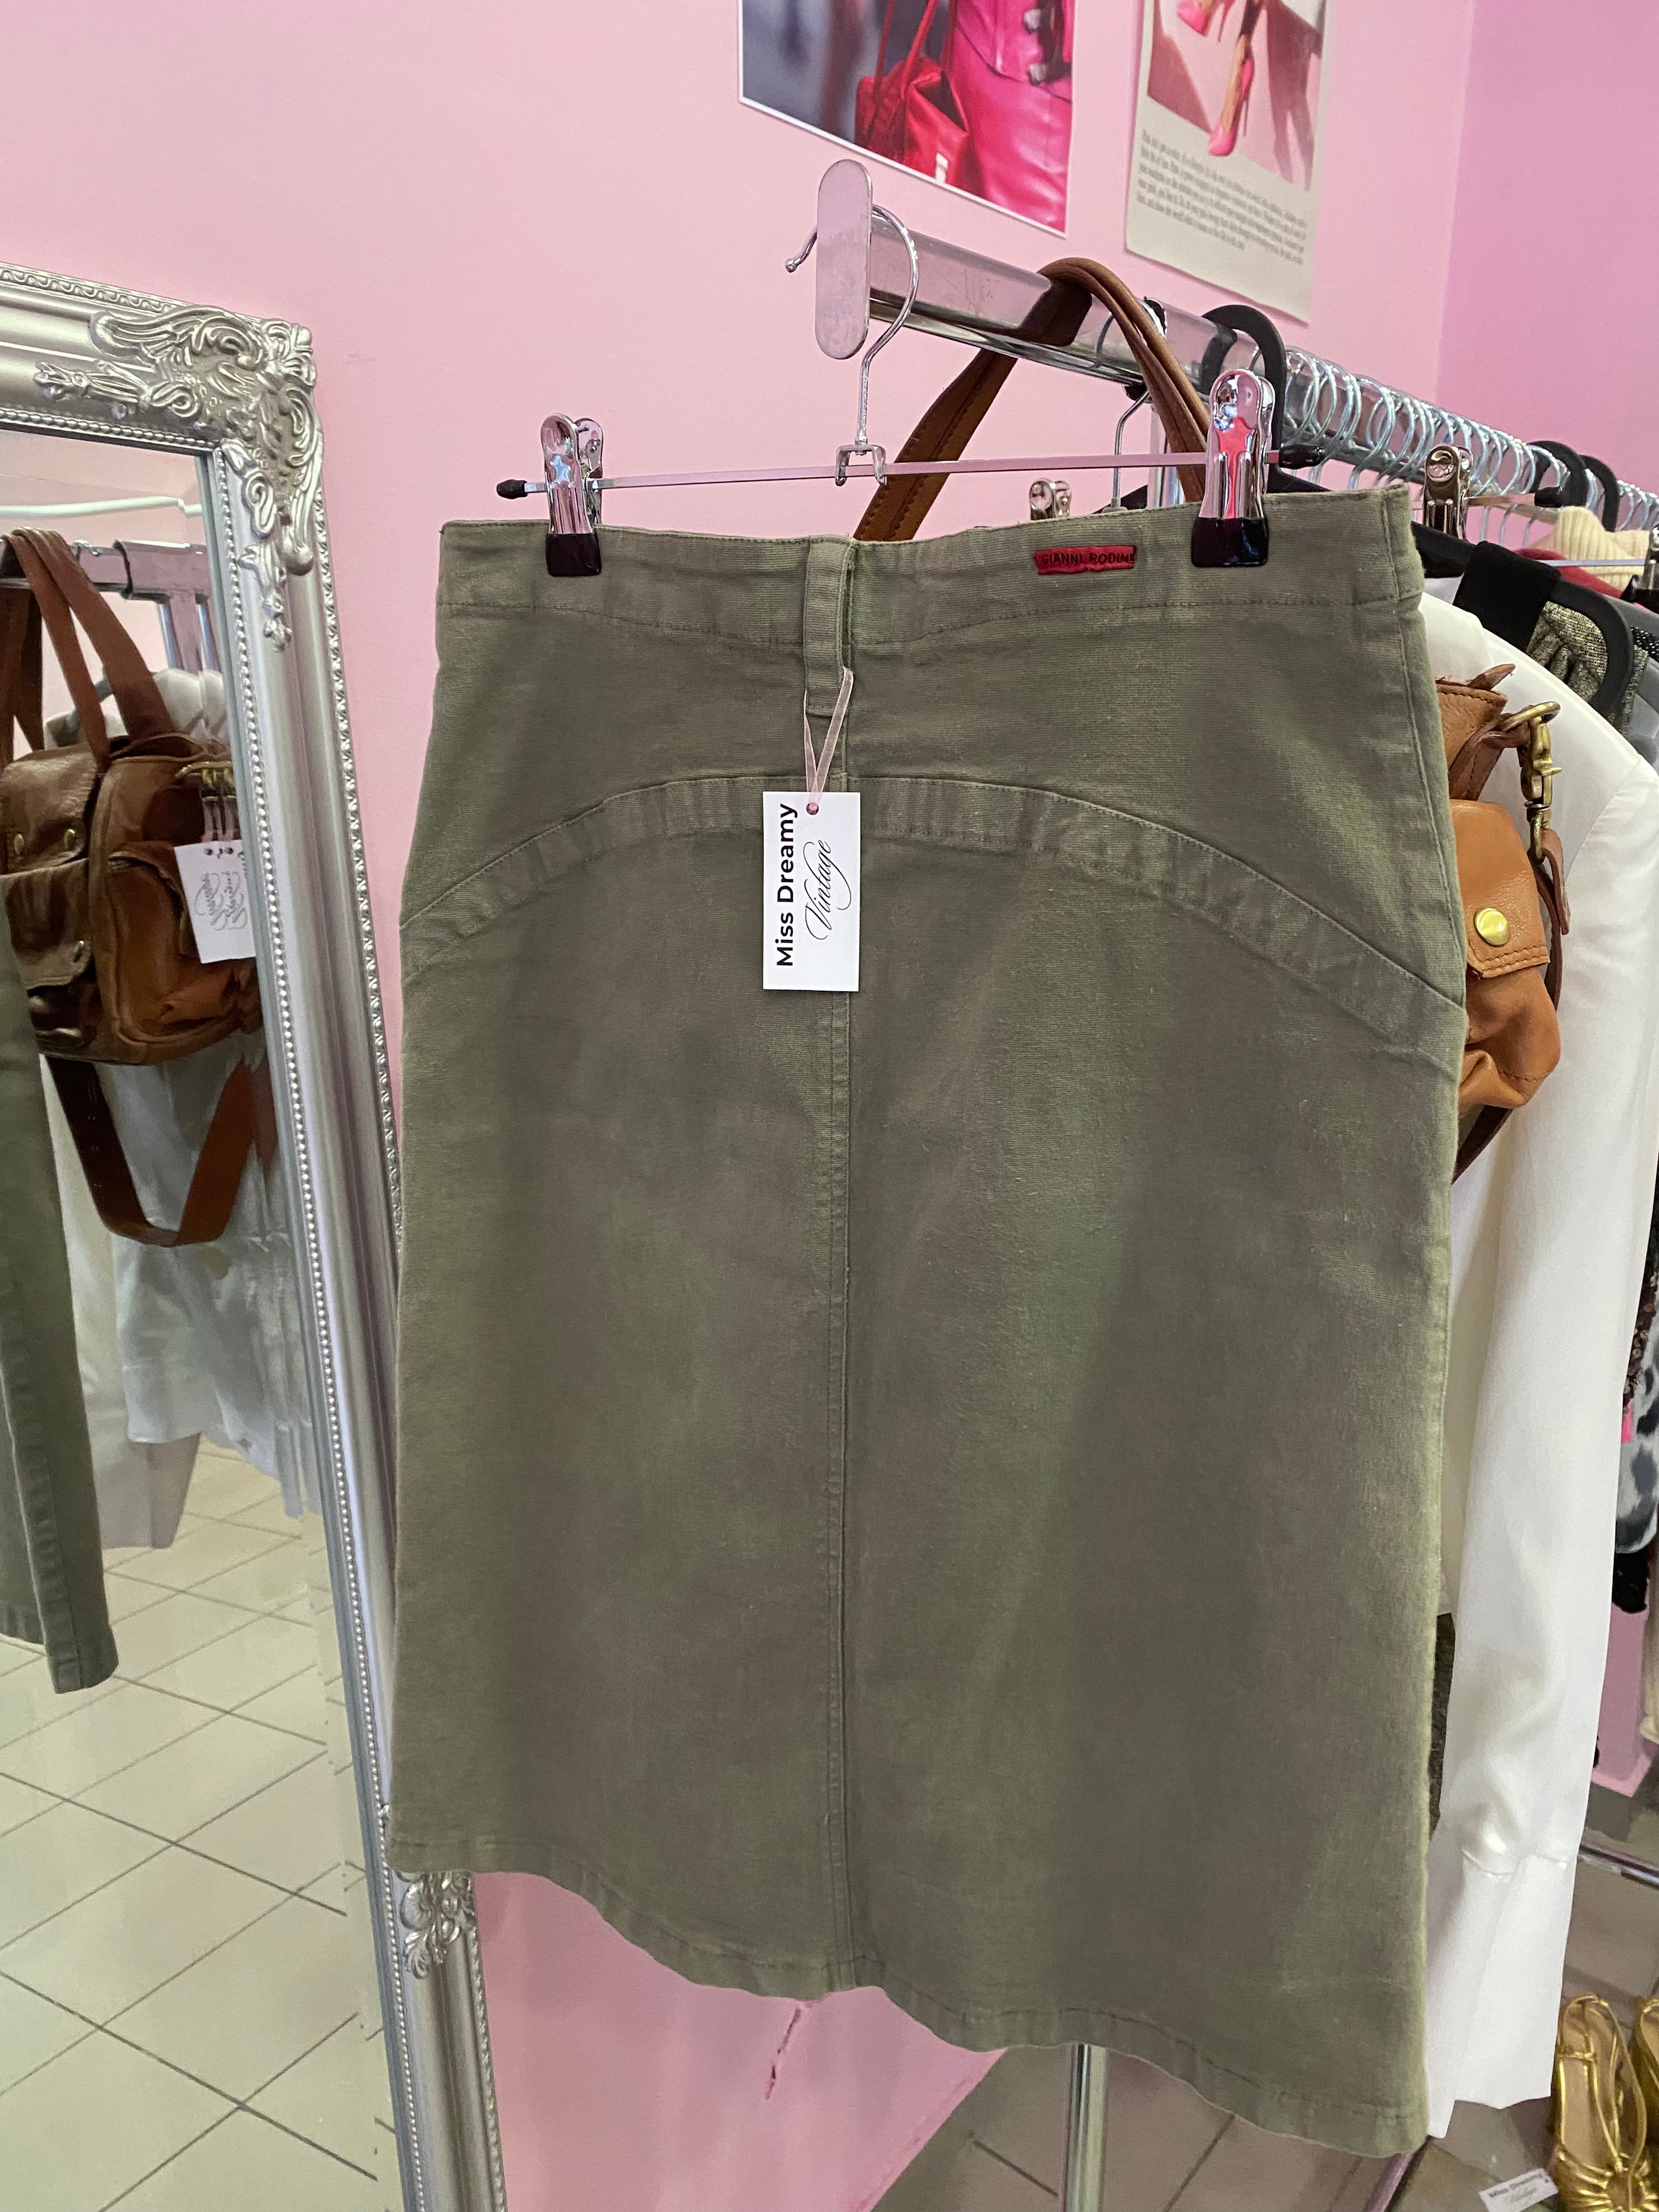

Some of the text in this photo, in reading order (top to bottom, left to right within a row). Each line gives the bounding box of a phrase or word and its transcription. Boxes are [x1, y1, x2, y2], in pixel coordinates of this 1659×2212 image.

[1042, 552, 1083, 565] GIANNI
[775, 803, 798, 966] Miss Dreamy
[803, 839, 851, 940] Vintage
